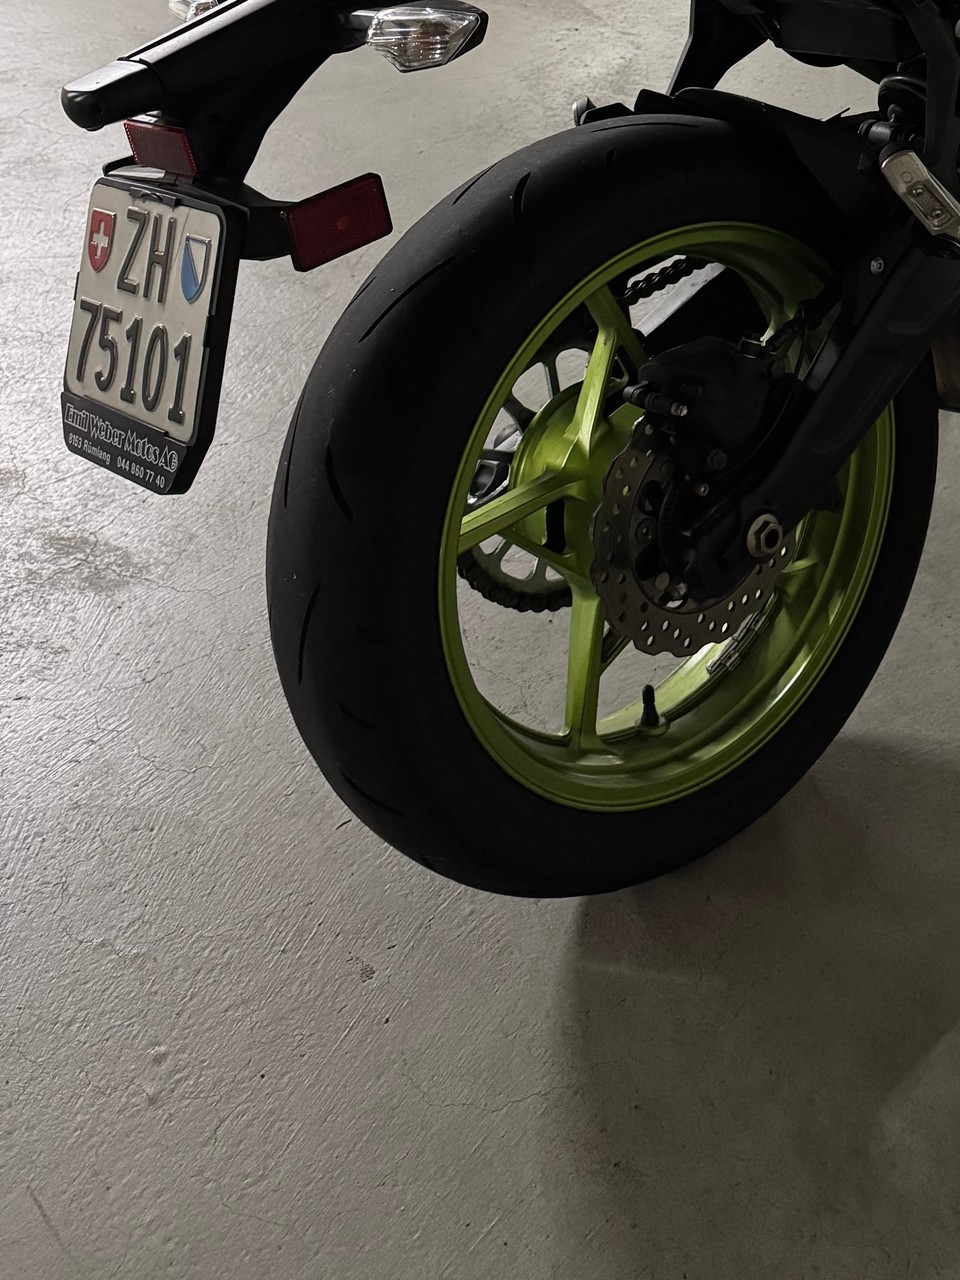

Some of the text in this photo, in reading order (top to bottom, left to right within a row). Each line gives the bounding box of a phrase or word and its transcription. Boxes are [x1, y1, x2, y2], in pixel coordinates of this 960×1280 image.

[116, 205, 177, 304] ZH
[76, 296, 192, 425] 75101
[64, 403, 178, 473] Emil Weber Motos AG
[68, 433, 111, 465] 8153 Rümlang
[117, 456, 130, 472] 044
[145, 469, 155, 483] 77
[155, 474, 165, 488] 40
